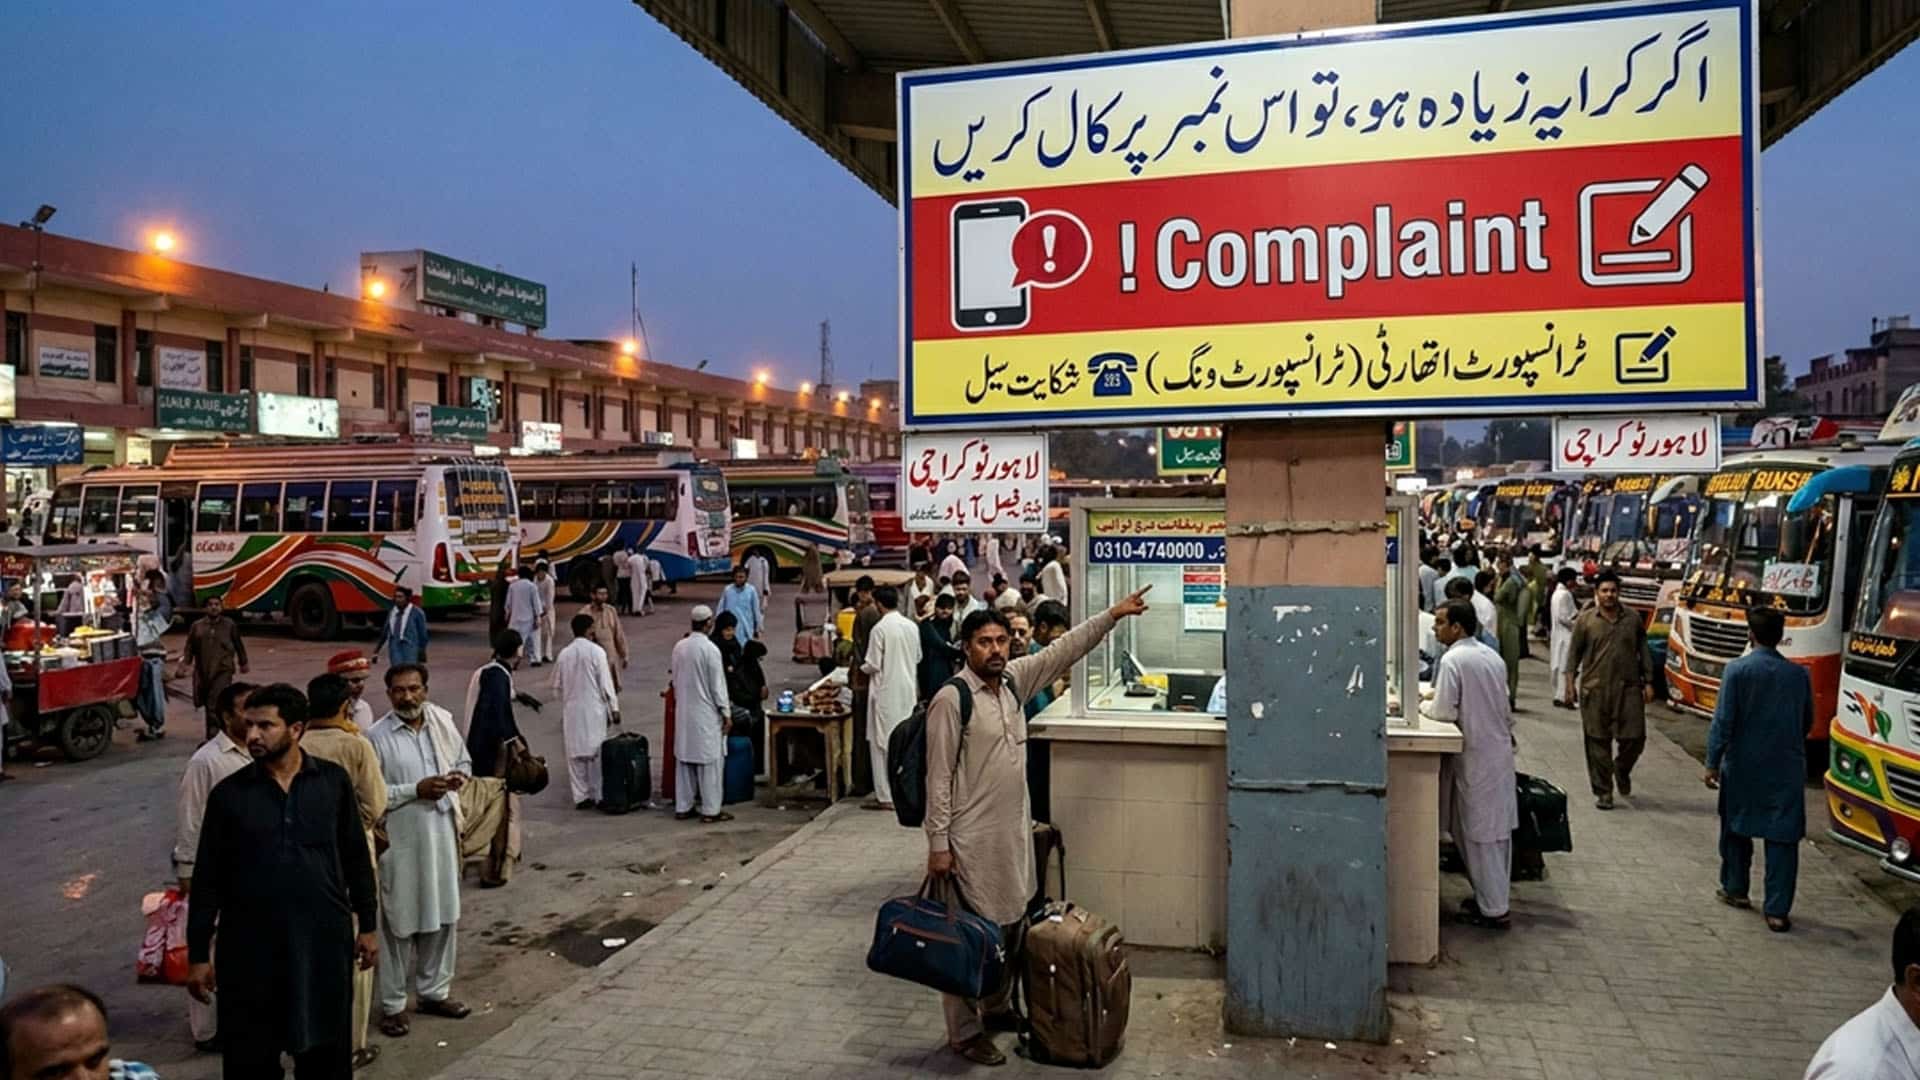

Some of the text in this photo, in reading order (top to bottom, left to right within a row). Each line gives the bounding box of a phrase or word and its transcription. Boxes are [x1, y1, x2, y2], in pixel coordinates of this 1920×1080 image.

[1529, 32, 1663, 142] کرایہ
[1635, 19, 1710, 114] اگر
[933, 86, 1053, 183] کریں
[1037, 88, 1123, 169] کال
[1154, 65, 1229, 162] نمبر
[1226, 89, 1297, 154] اس
[1307, 71, 1339, 138] تو
[1418, 71, 1530, 142] زیادہ
[1112, 114, 1148, 176] پر
[1157, 199, 1550, 299] Complaint
[966, 354, 1009, 404] سیل
[1007, 362, 1080, 401] شکایت
[1368, 324, 1450, 391] اتھارٹی
[1453, 322, 1588, 388] ٹرانسپورٹ
[909, 438, 980, 494] کراچی
[985, 450, 1040, 481] لاہور
[1564, 420, 1707, 468] لاہور ٹو کراچی
[1094, 540, 1205, 559] 0310-4740000
